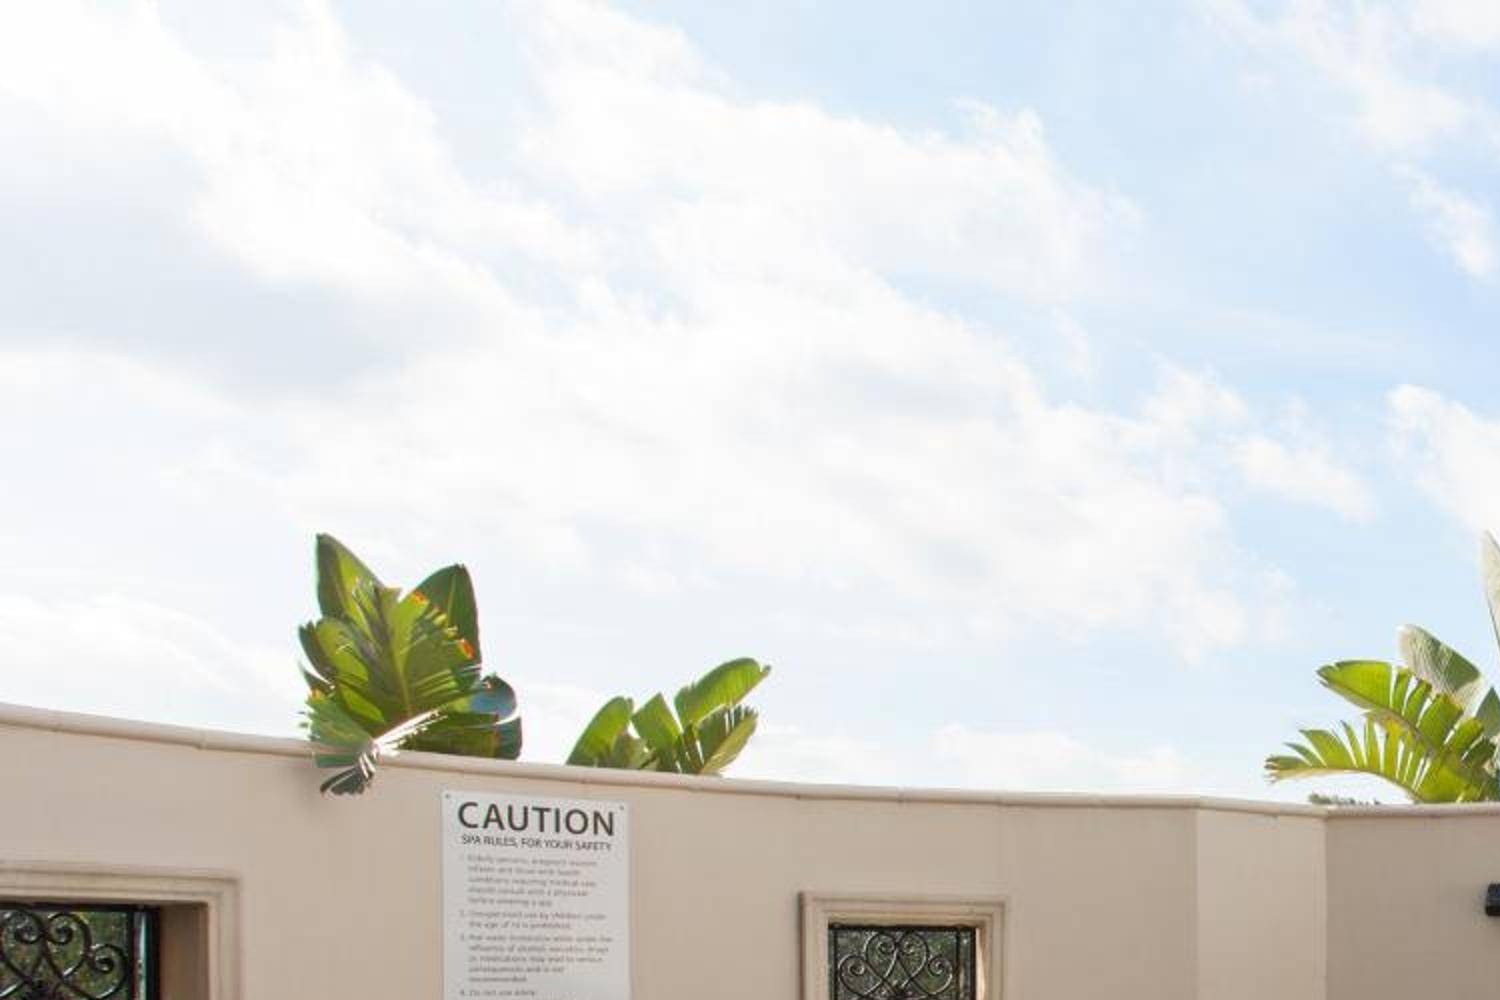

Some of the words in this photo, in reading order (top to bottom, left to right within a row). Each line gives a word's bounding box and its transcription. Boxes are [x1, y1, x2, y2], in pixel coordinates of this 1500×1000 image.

[457, 801, 615, 837] CAUTION
[461, 834, 481, 845] SPA
[521, 838, 543, 848] FOR
[545, 839, 573, 850] YOUR
[575, 841, 612, 852] SAFETY
